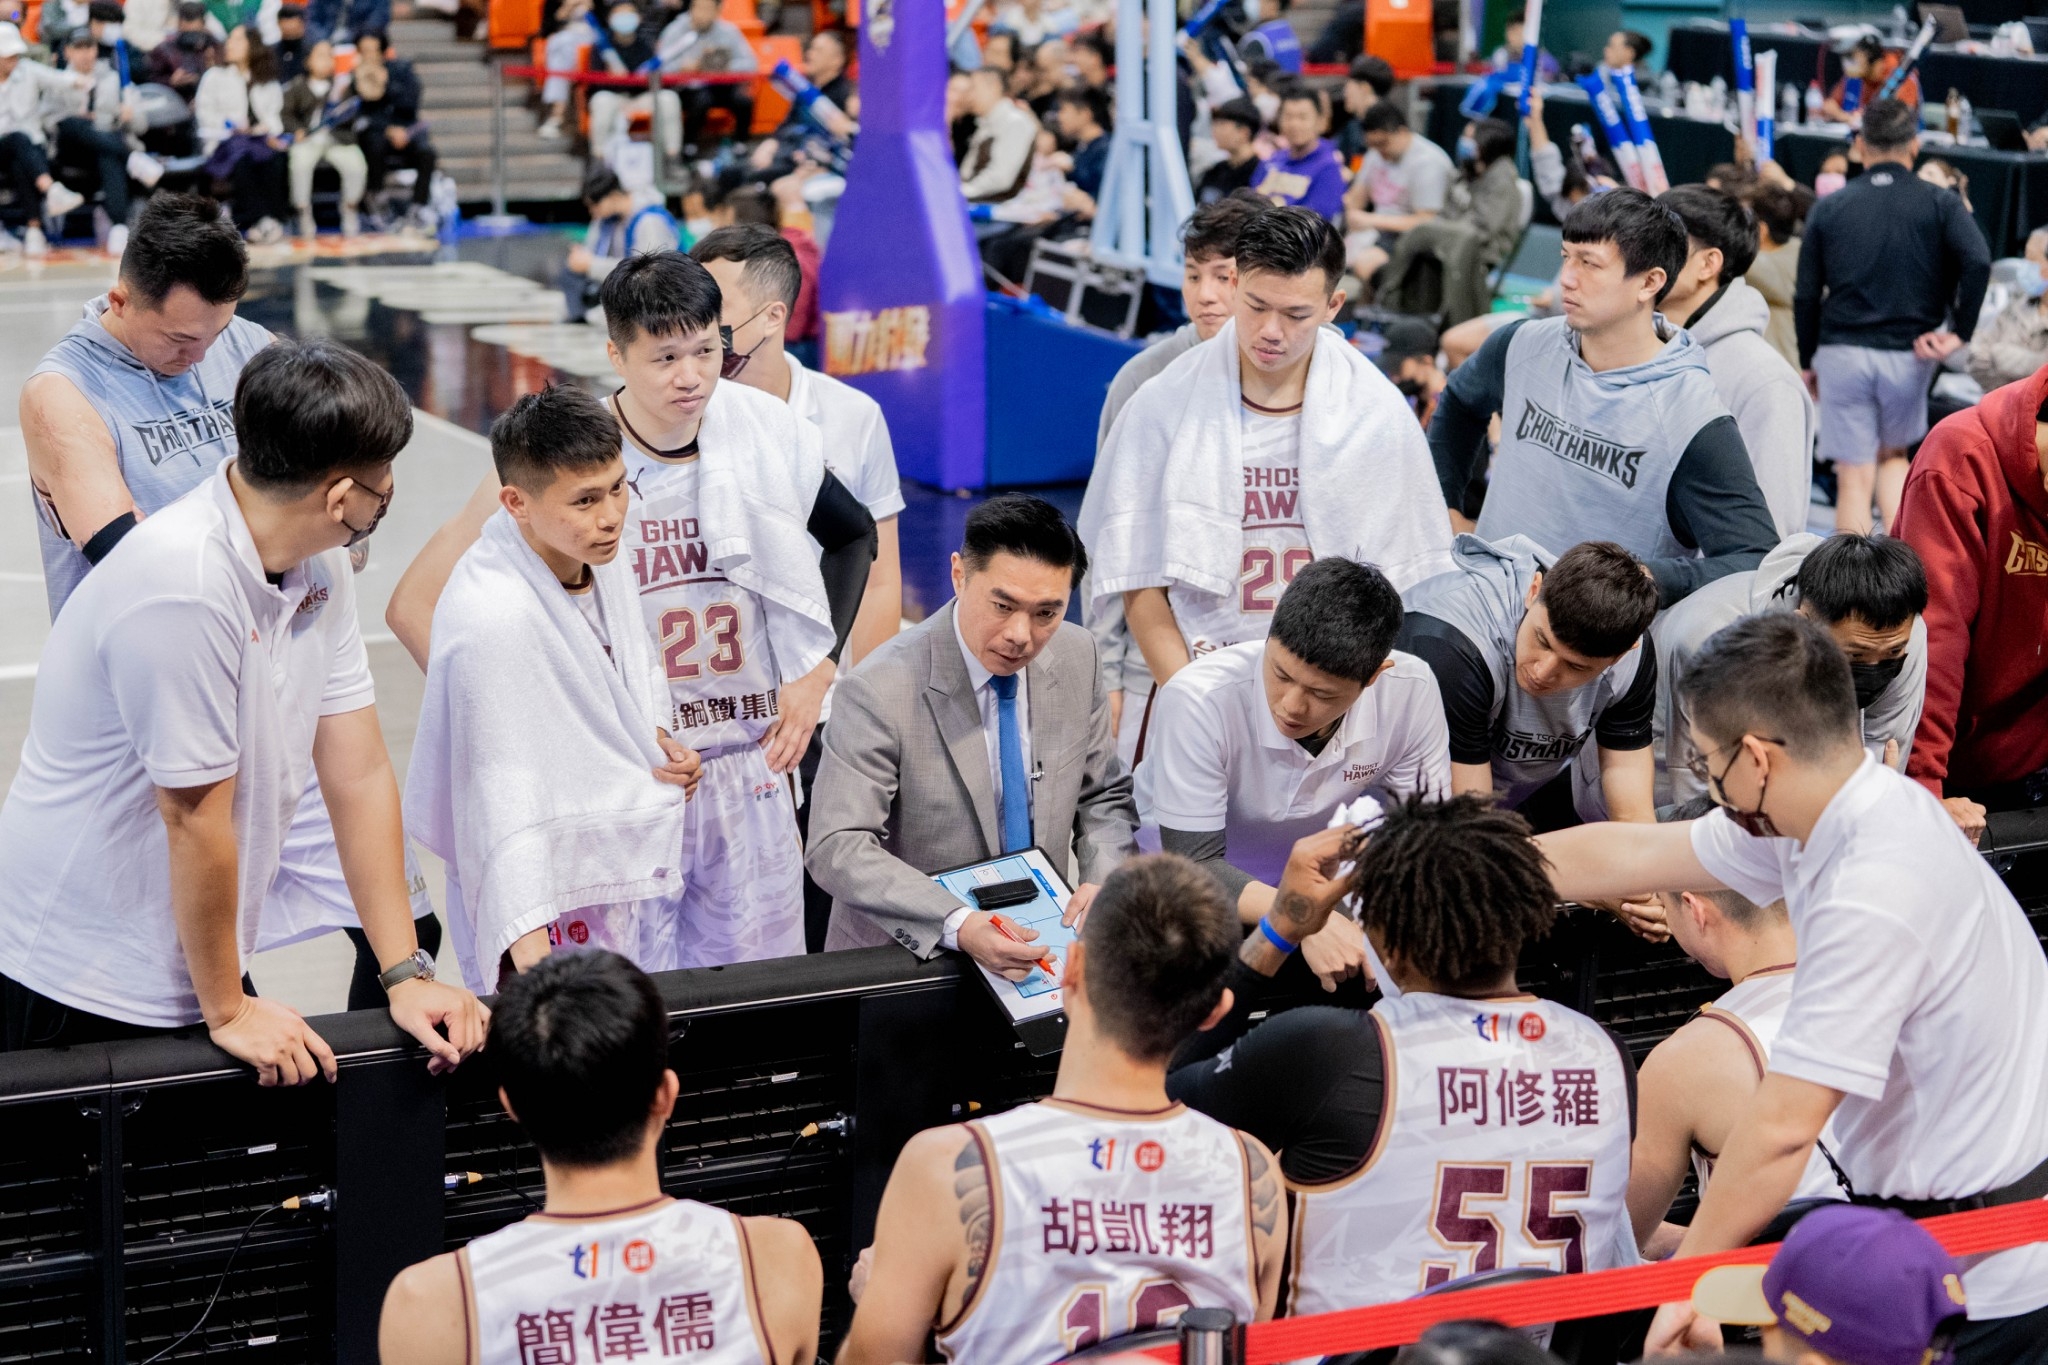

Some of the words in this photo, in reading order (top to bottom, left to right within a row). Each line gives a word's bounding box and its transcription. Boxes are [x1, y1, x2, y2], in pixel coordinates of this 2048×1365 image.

[639, 517, 700, 544] GHO
[632, 541, 710, 587] HAW
[657, 601, 746, 683] 23
[1437, 1066, 1599, 1127] 阿修羅
[1042, 1198, 1213, 1259] 胡凱翔
[1418, 1159, 1594, 1291] 55
[515, 1292, 715, 1365] 簡偉儒
